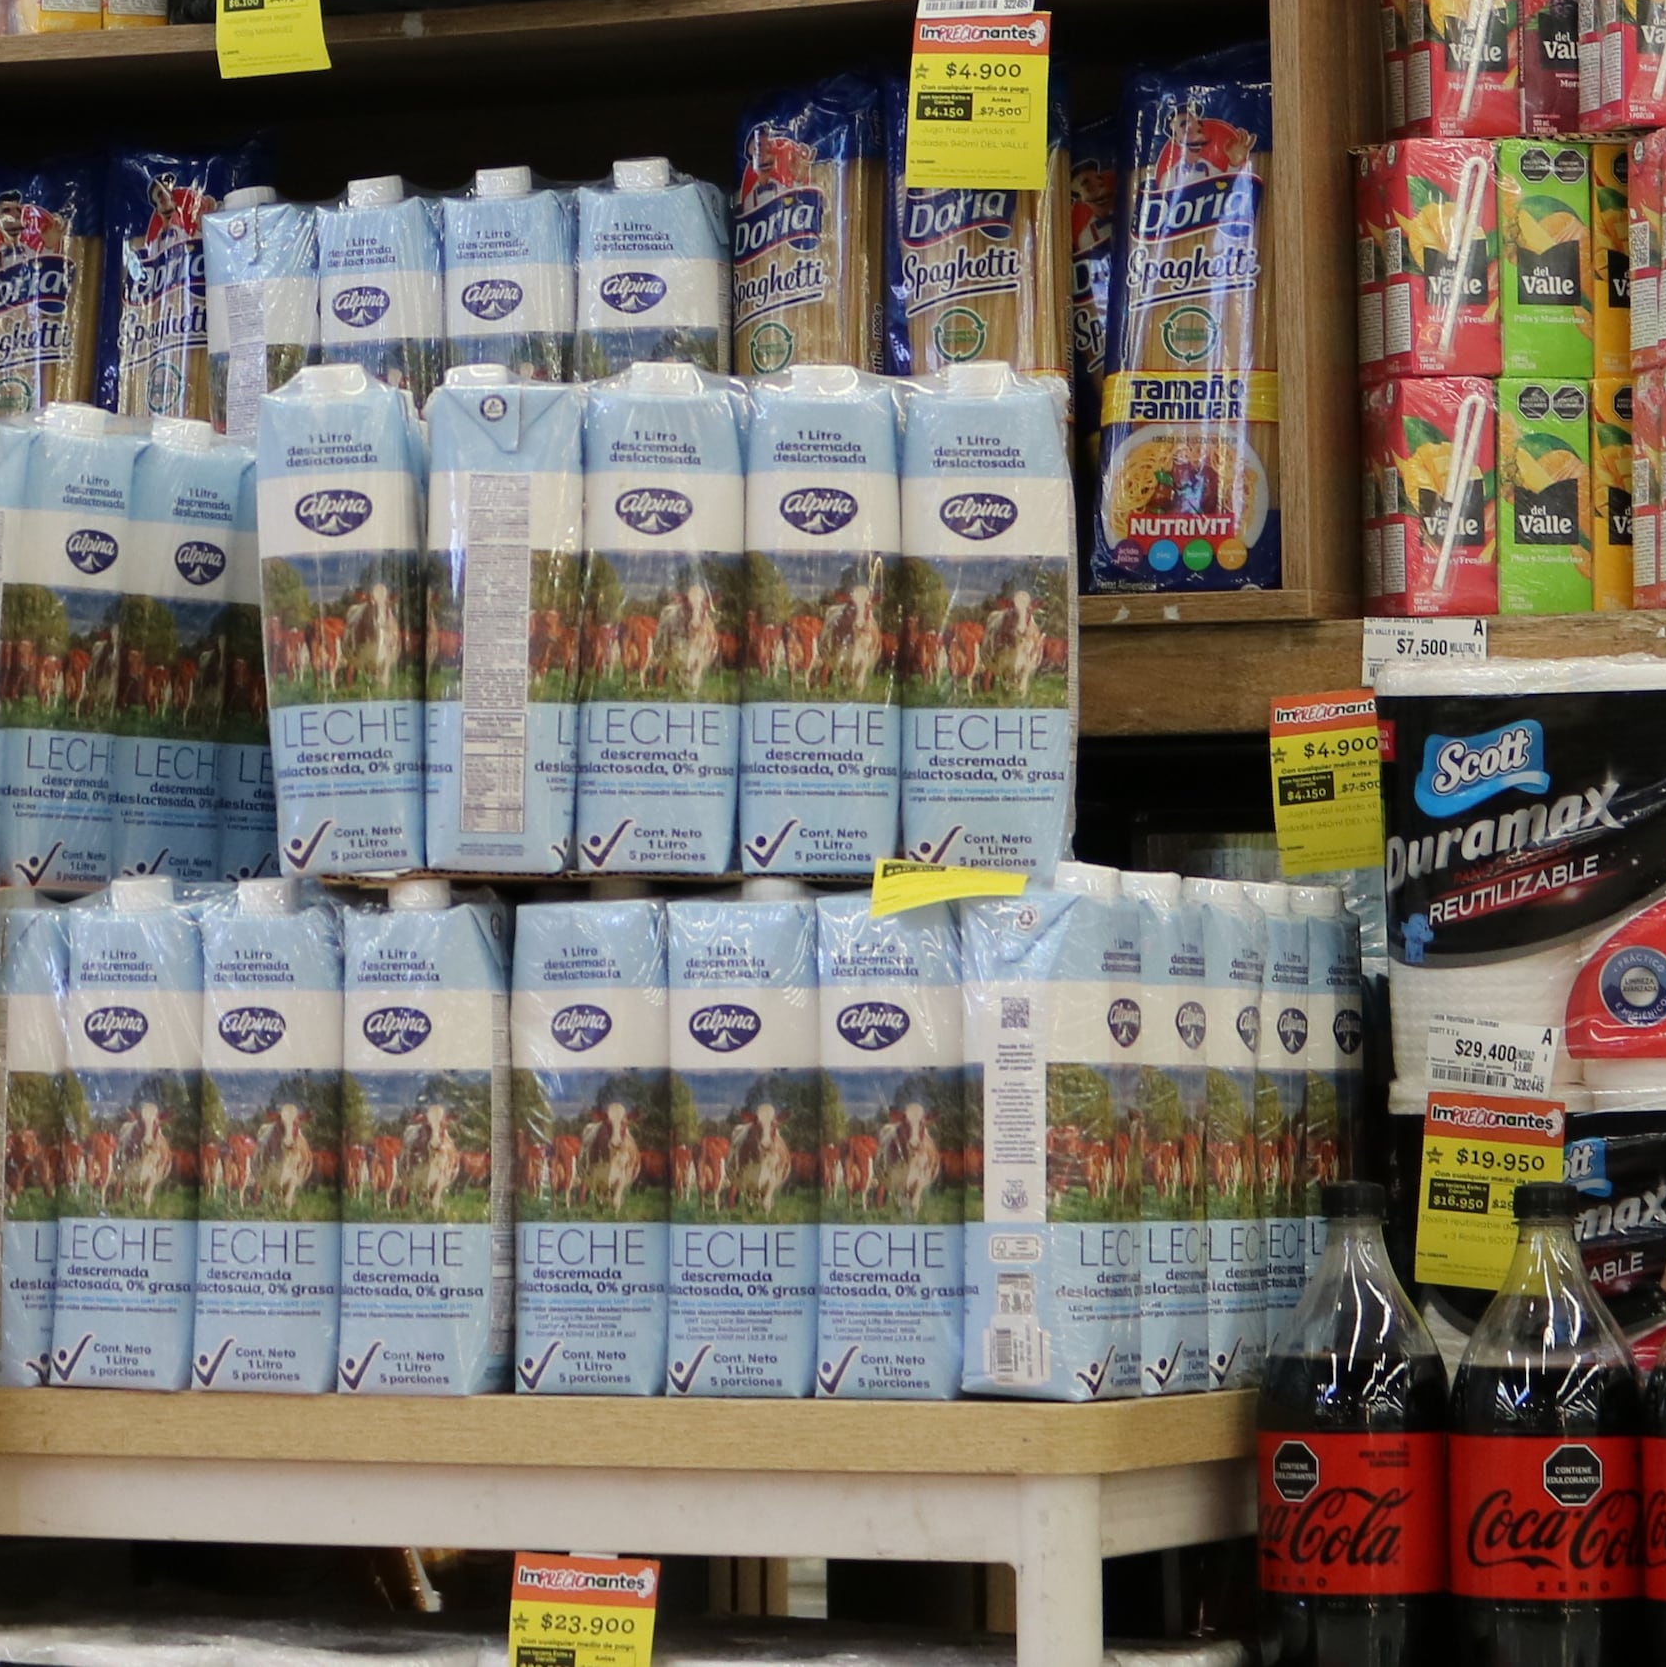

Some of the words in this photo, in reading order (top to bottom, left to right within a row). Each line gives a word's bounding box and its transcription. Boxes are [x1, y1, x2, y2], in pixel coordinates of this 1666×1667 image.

[945, 62, 1021, 79] $4.900
[1523, 277, 1574, 297] Valle
[808, 430, 842, 441] Litro
[775, 441, 861, 453] descremada
[773, 453, 867, 465] deslactosada
[1130, 517, 1231, 536] NUTRIVIT
[279, 706, 410, 749] LECHE
[749, 709, 886, 747] LECHE
[1454, 1039, 1517, 1062] $29,400
[1456, 1148, 1544, 1172] $19.950
[1433, 1196, 1483, 1209] $16.950
[821, 1230, 945, 1270] LECHE
[541, 1612, 635, 1635] $23.900
